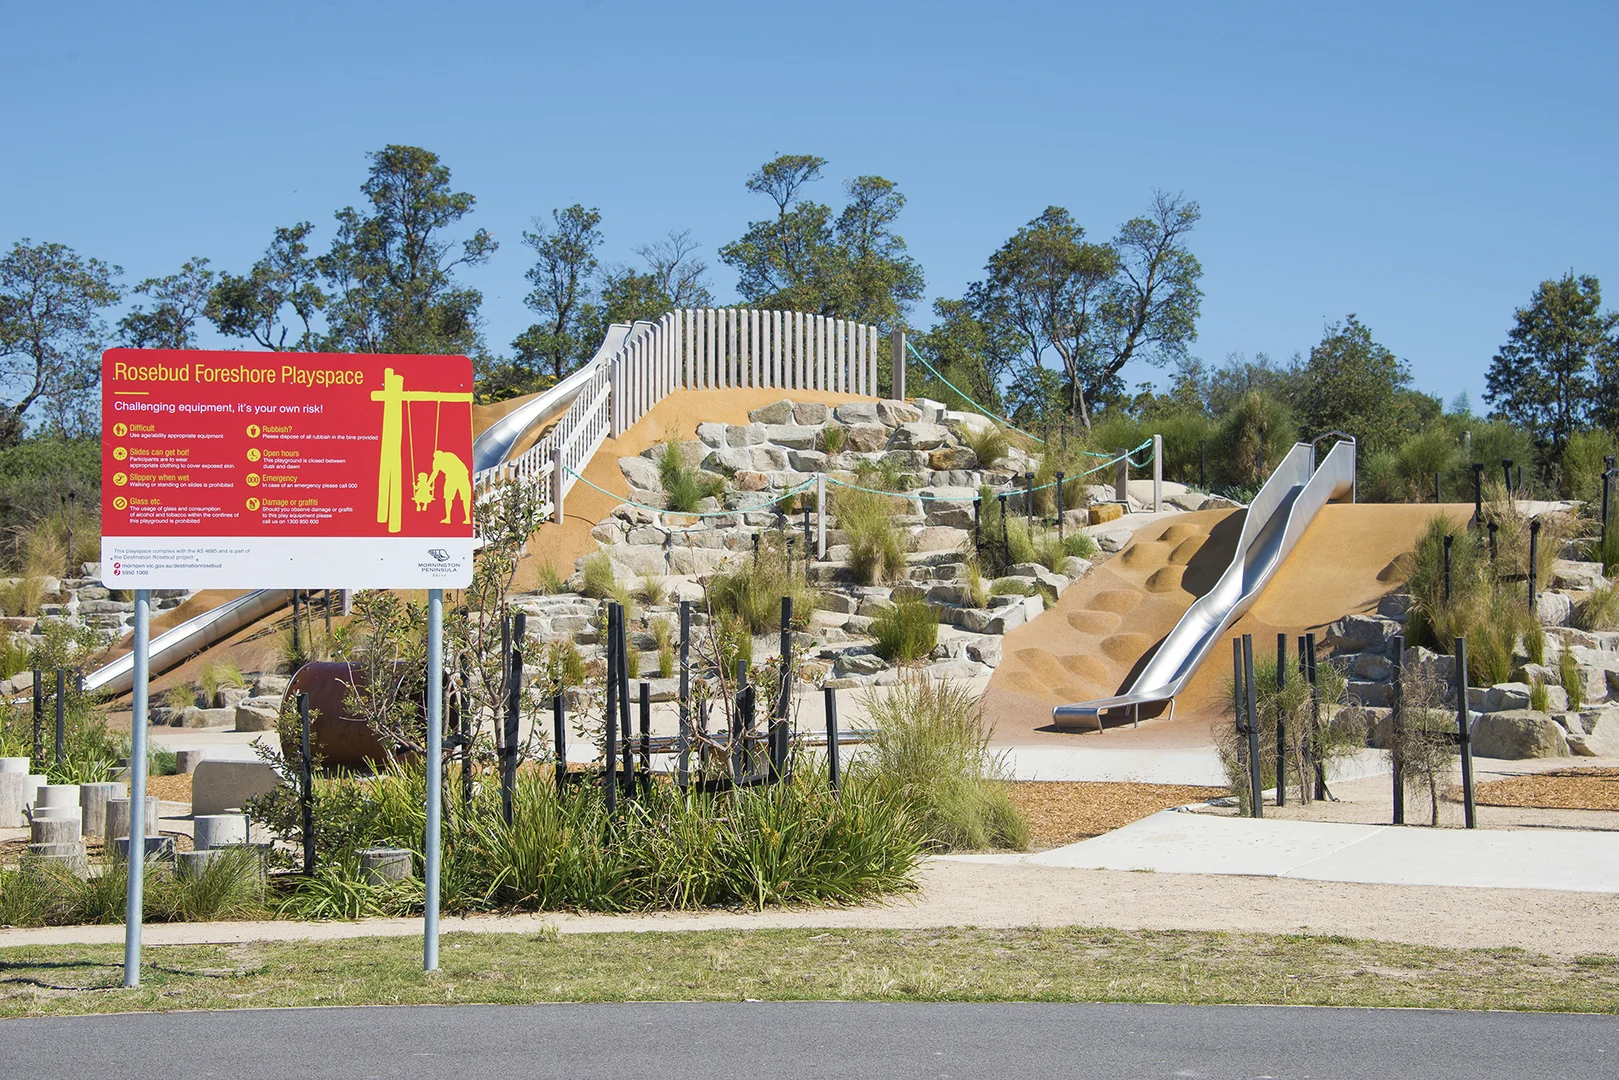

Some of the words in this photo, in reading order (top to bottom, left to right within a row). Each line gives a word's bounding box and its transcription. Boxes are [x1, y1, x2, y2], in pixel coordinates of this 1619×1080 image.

[115, 363, 189, 381] Rosebud
[196, 364, 275, 383] Foreshore
[281, 366, 363, 388] Playspace
[114, 402, 175, 413] Challenging
[178, 404, 234, 414] equipment,
[238, 404, 251, 412] it's
[254, 405, 276, 414] your
[302, 405, 322, 413] risk!
[130, 474, 156, 482] Slippery
[263, 474, 298, 483] Emergency
